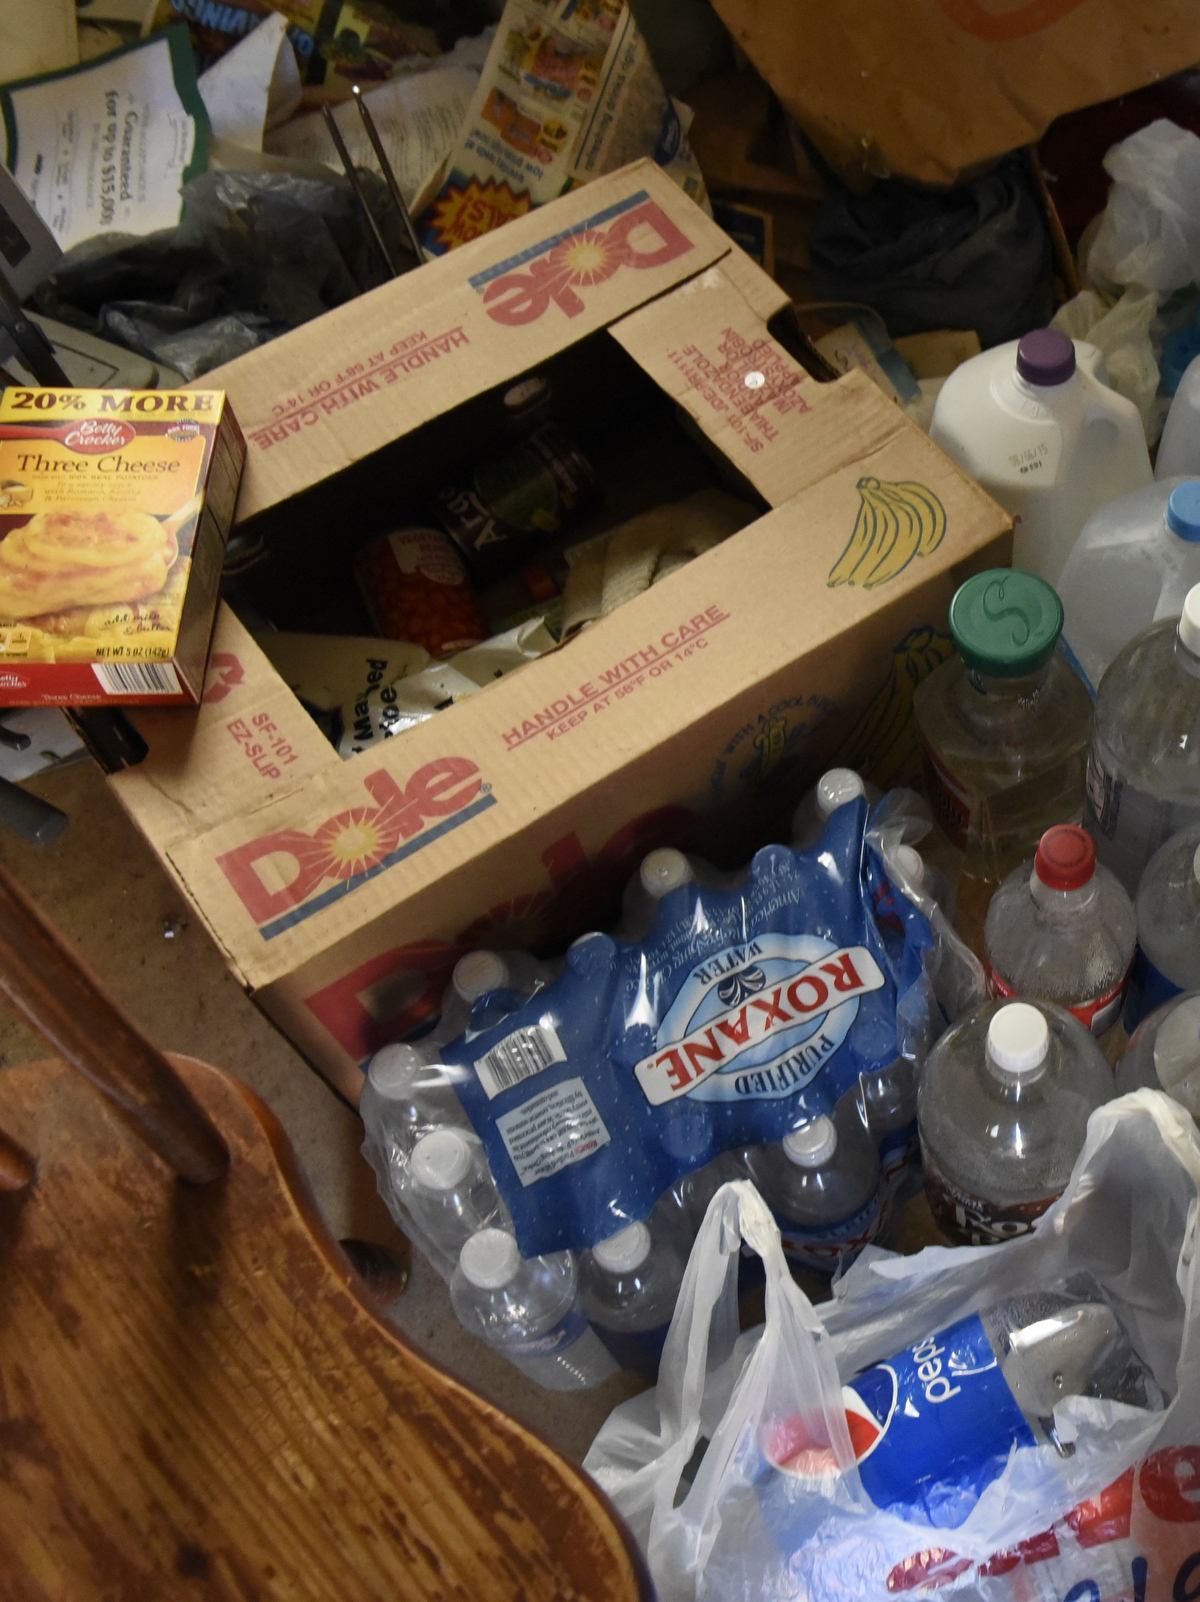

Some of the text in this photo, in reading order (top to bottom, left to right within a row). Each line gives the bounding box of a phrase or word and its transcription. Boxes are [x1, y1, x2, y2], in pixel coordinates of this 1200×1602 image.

[103, 90, 119, 116] for
[102, 123, 116, 142] up
[102, 146, 115, 161] to
[117, 111, 139, 201] Guaranteed
[482, 200, 694, 326] Dole
[365, 350, 386, 368] AT
[387, 329, 426, 357] KEEP
[11, 392, 215, 412] 20% MORE
[253, 327, 469, 452] HANDLE WITH CARE
[307, 379, 332, 399] OR
[64, 430, 126, 447] Crocker
[80, 419, 122, 436] Betty
[17, 454, 181, 473] Three Cheese
[96, 648, 112, 658] NET
[113, 647, 125, 657] WT
[126, 647, 132, 656] 5
[133, 647, 143, 656] OZ
[501, 603, 724, 748] HANDLE WITH CARE
[546, 708, 590, 741] KEEP
[590, 694, 613, 713] AT
[647, 658, 673, 679] OR
[673, 636, 709, 663] 14°C
[226, 715, 281, 784] EZ-SLIP
[250, 709, 298, 767] SF-101
[216, 756, 486, 924] Dole
[692, 933, 763, 992] WATER
[653, 949, 867, 1091] ROXANE
[729, 1021, 837, 1111] PURIFIED
[924, 1334, 959, 1402] peps
